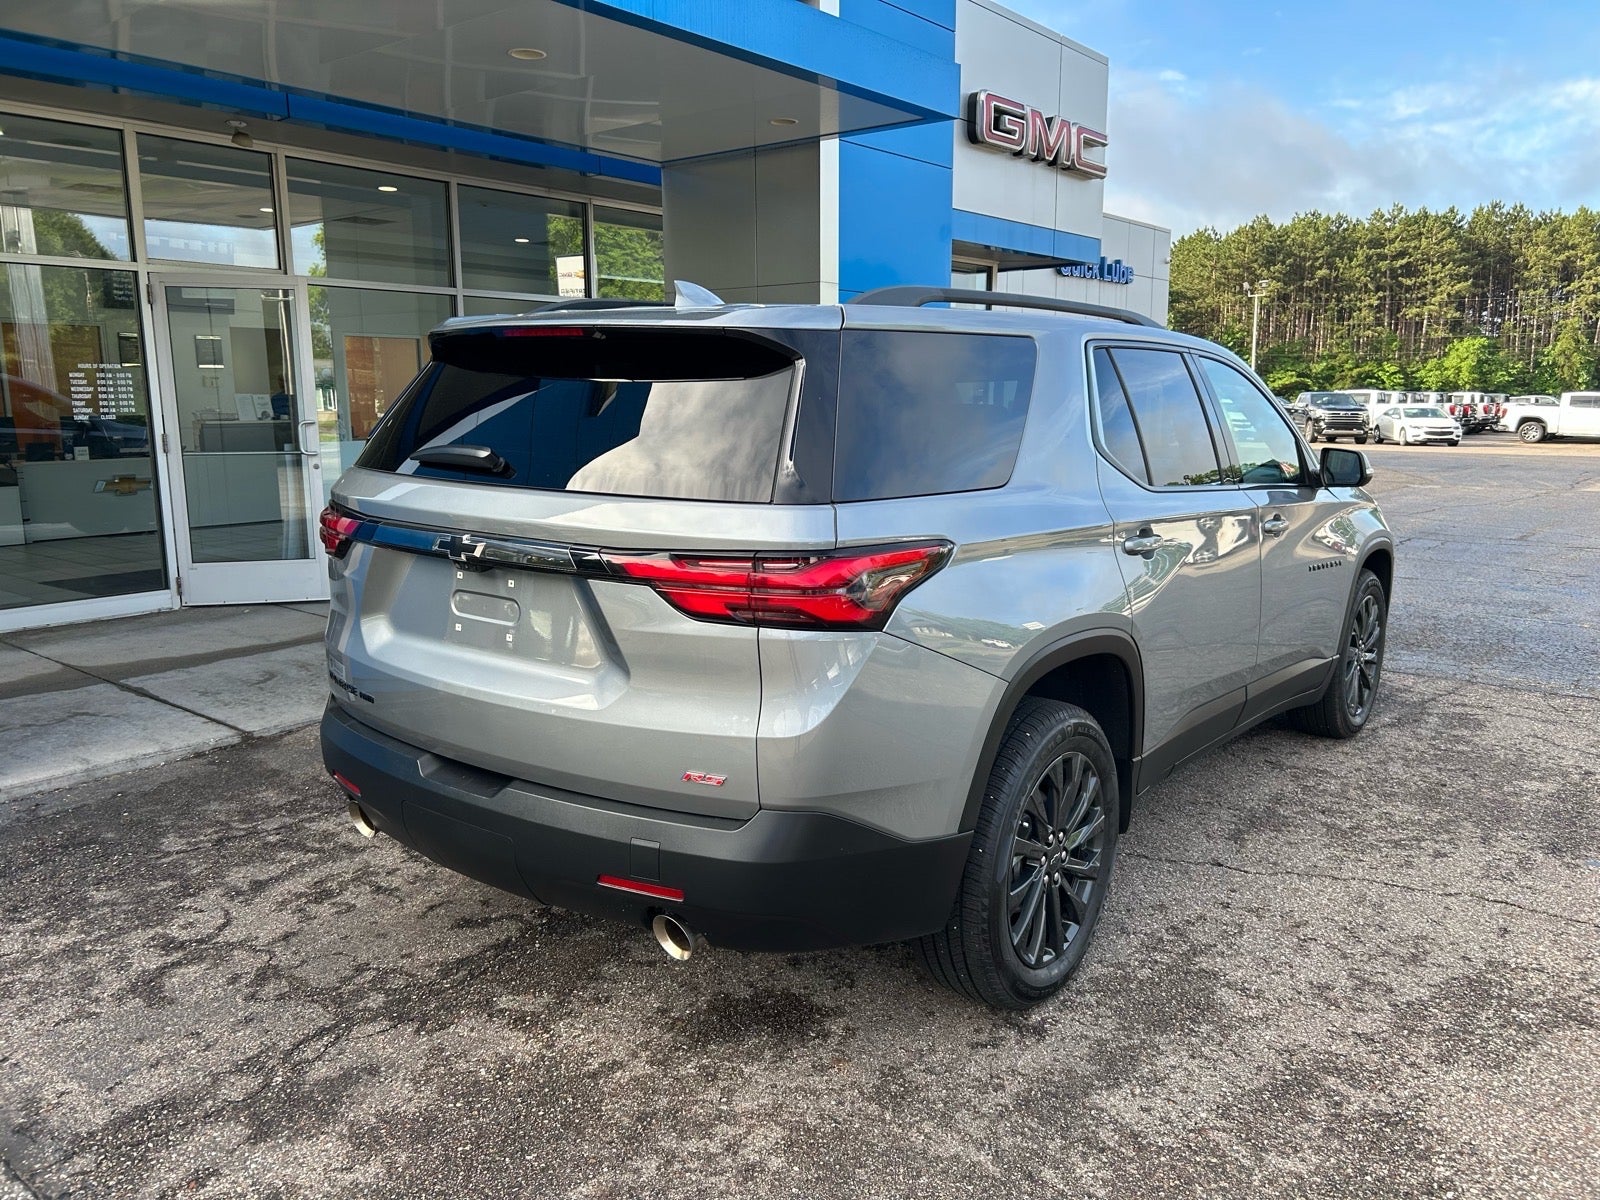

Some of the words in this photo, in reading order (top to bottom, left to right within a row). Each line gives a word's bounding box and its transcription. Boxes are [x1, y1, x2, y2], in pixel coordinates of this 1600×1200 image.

[970, 89, 1108, 179] GMC
[1101, 256, 1134, 285] Lube
[1308, 560, 1342, 572] TRAVERSE
[681, 770, 727, 787] RS
